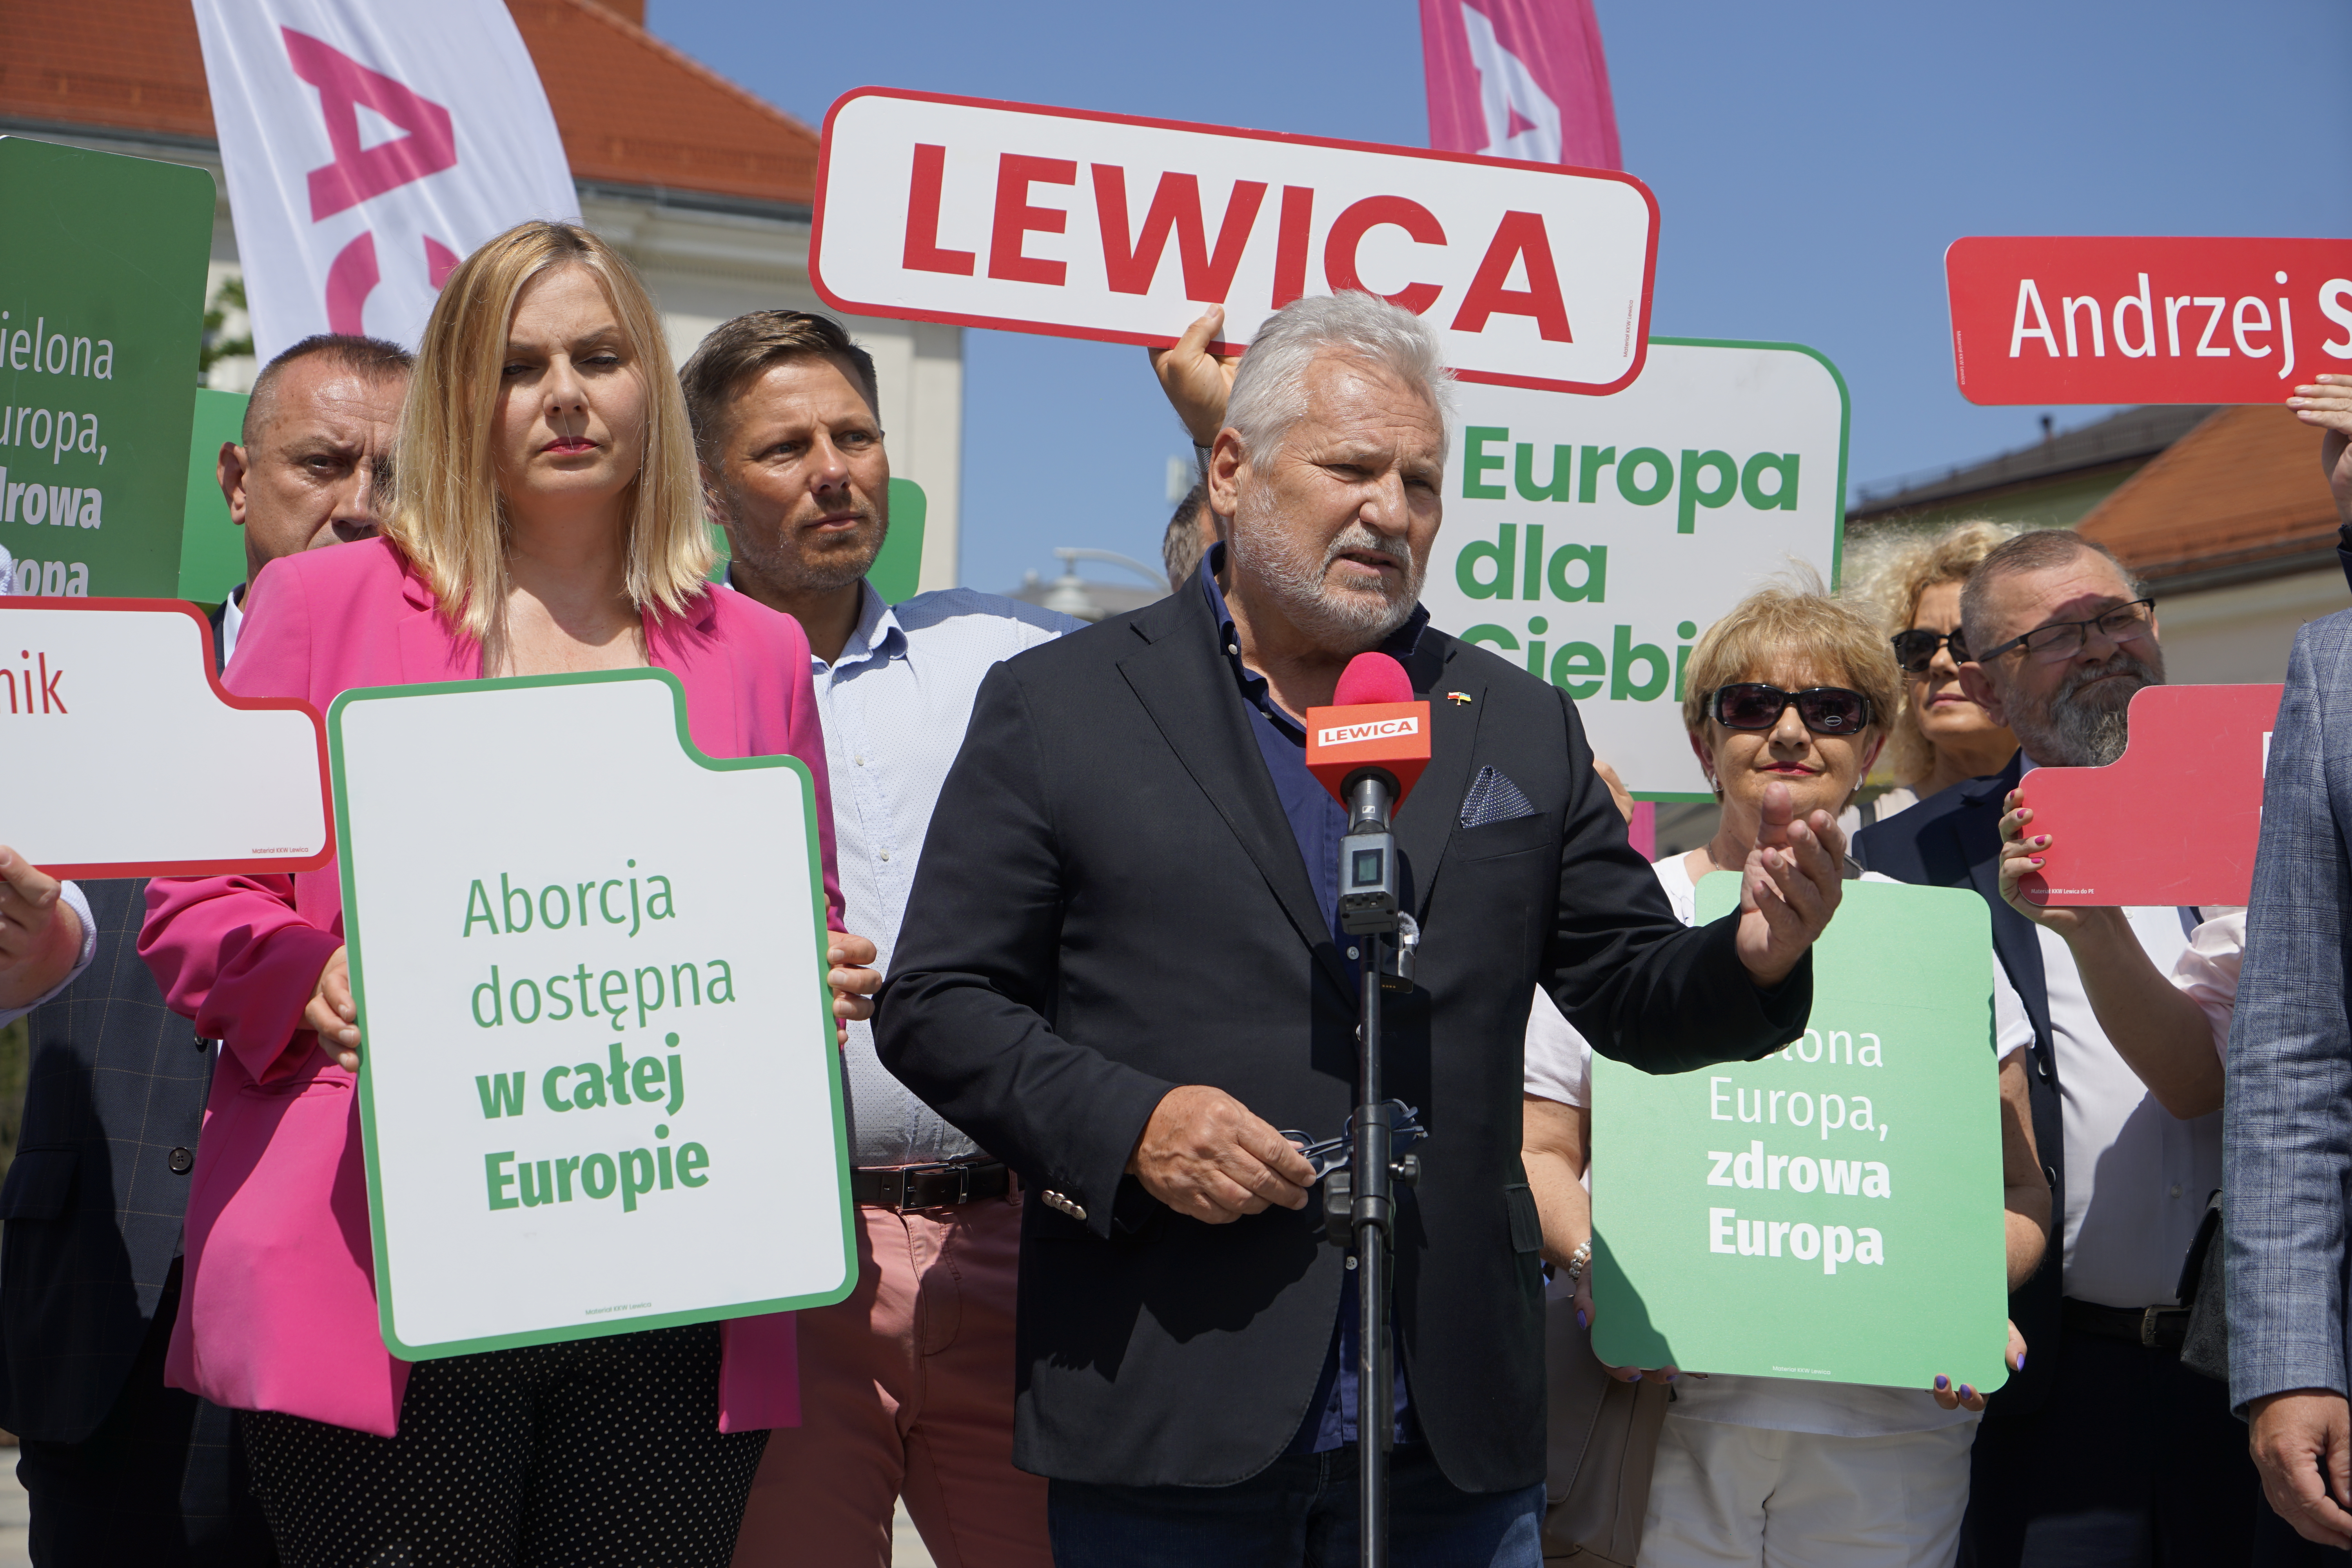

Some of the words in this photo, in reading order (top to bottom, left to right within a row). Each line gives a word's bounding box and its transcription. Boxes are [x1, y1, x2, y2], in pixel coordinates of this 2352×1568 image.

[903, 143, 1572, 343] LEWICA
[2010, 271, 2294, 379] Andrzej
[0, 466, 102, 530] rowa
[1463, 426, 1799, 534] Europa
[1455, 523, 1607, 602] dla
[1325, 721, 1413, 742] LEWICA
[463, 859, 675, 937] Aborcja
[472, 960, 735, 1031] dostępna
[475, 1072, 524, 1118] w
[543, 1033, 684, 1116] całej
[1711, 1076, 1888, 1142] Europa,
[485, 1124, 709, 1212] Europie
[1707, 1140, 1891, 1199] zdrowa
[1710, 1207, 1884, 1274] Europa
[2145, 1318, 2153, 1342] STNLEY
